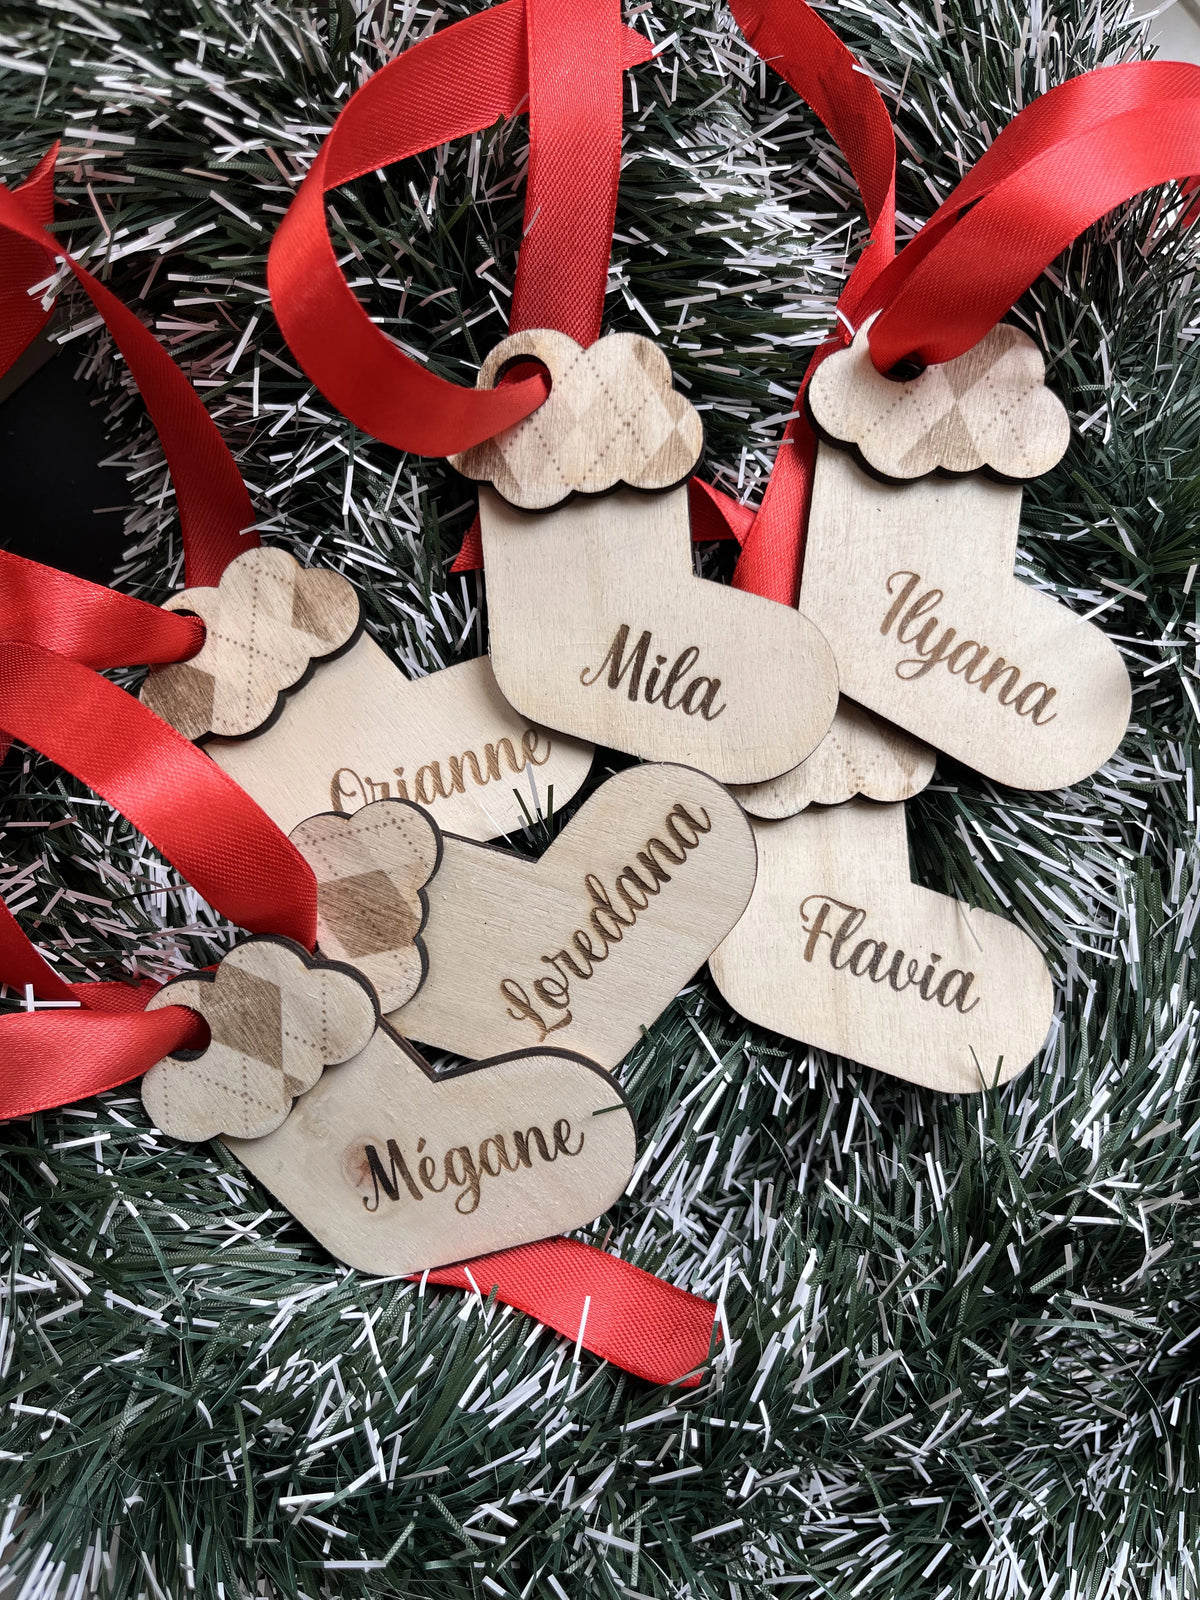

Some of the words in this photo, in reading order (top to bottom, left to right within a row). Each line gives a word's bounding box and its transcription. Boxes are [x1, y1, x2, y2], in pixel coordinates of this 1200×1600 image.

[580, 624, 727, 721] Mila
[880, 570, 1058, 726] Ilyana
[330, 728, 551, 812] Orianne
[500, 803, 712, 1043] Loredana
[800, 894, 981, 1014] Flavia
[362, 1118, 585, 1215] Mégane
